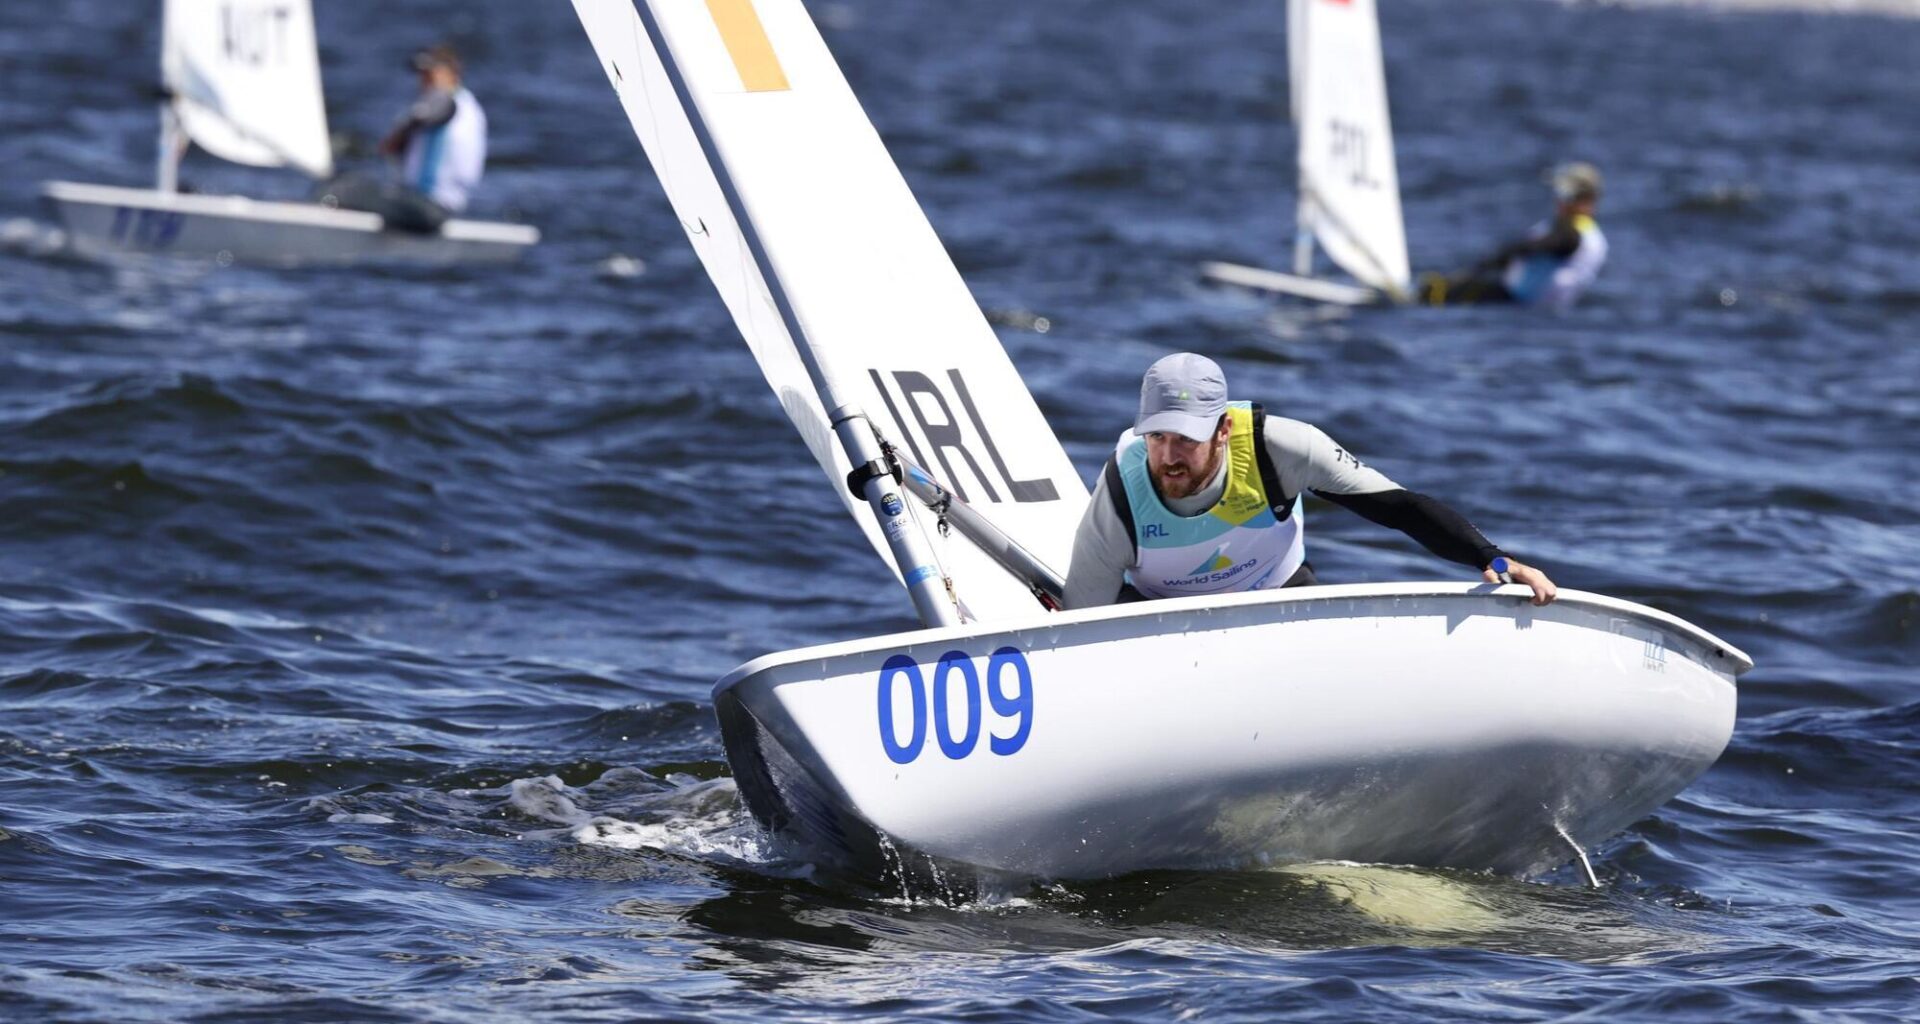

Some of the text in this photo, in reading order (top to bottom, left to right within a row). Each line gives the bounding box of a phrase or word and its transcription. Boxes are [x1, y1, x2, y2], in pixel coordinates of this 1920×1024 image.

[868, 368, 1061, 503] IRL
[1142, 524, 1169, 538] IRL
[1163, 558, 1257, 586] World Sailing
[878, 646, 1034, 764] 009
